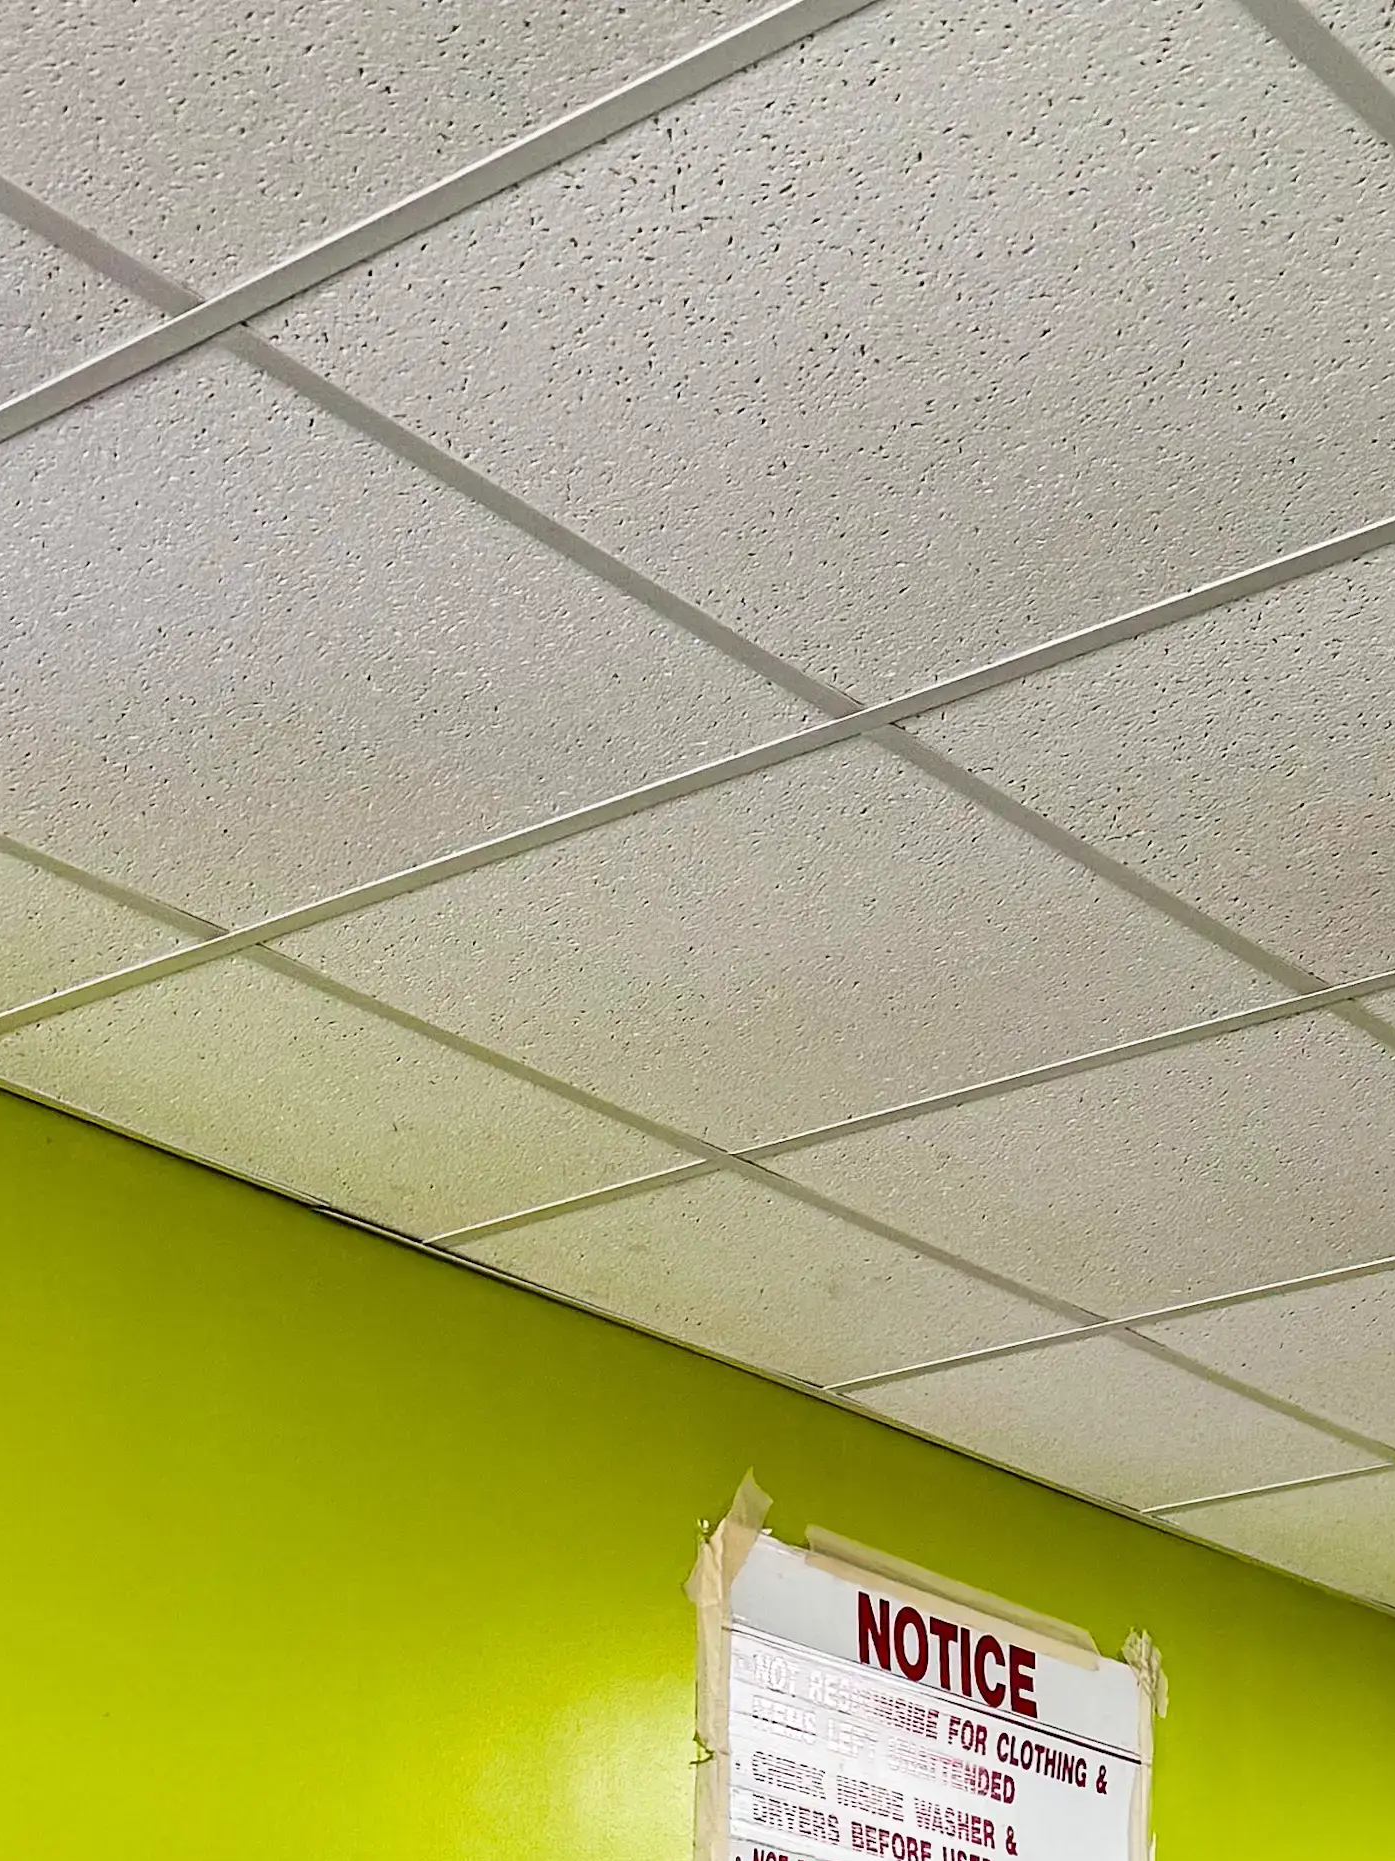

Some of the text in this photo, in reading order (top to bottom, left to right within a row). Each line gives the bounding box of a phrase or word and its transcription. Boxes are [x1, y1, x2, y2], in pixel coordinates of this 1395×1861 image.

[857, 1591, 1038, 1719] NOTICE
[948, 1715, 987, 1756] FOR
[997, 1732, 1087, 1788] CLOTHING
[1096, 1764, 1107, 1794] &
[753, 1793, 840, 1845] DRYERS
[914, 1797, 995, 1849] WASHER
[1006, 1825, 1018, 1856] &
